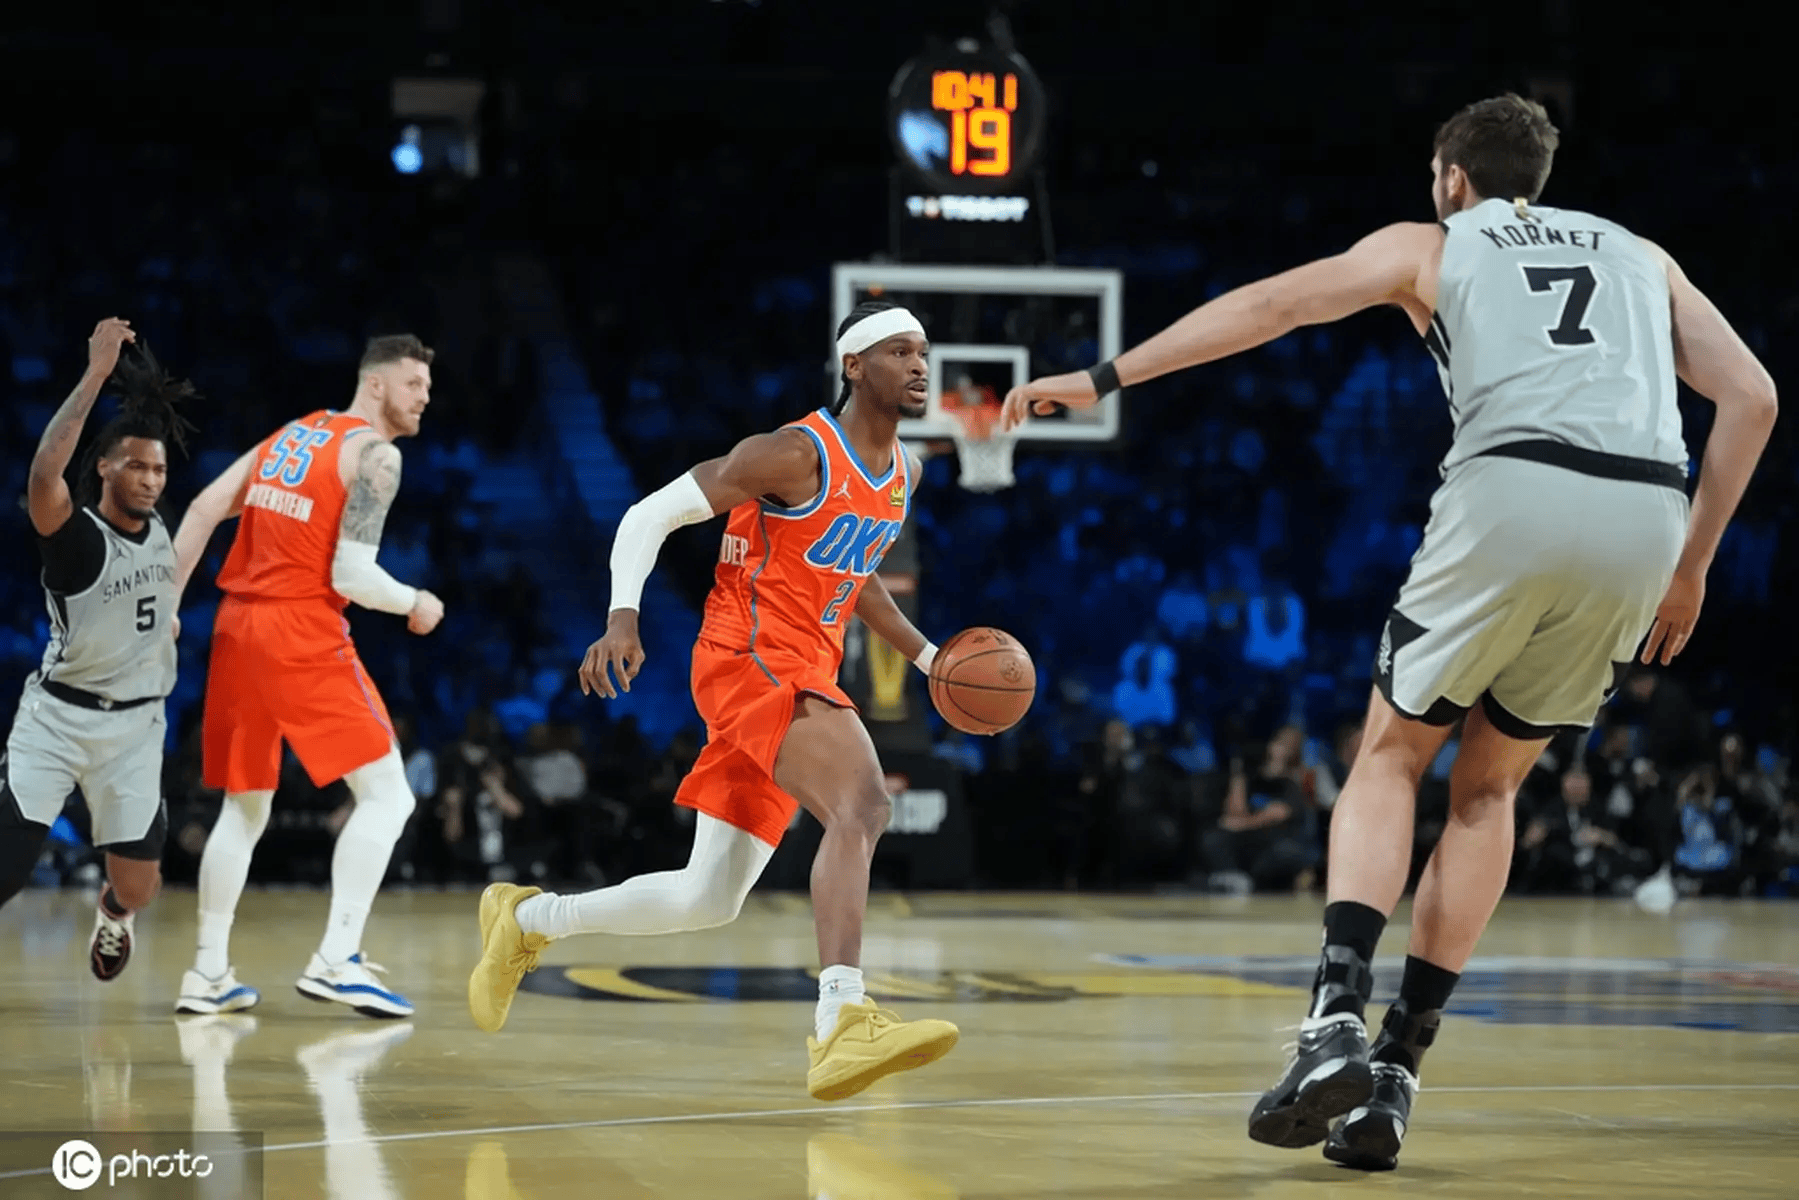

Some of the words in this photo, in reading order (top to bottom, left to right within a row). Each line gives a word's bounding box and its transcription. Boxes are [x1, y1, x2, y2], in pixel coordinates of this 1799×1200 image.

[950, 108, 1011, 175] 19
[1480, 224, 1605, 251] KORNET
[1519, 262, 1601, 348] 7
[260, 424, 334, 487] 55
[103, 575, 132, 603] SAN
[820, 580, 856, 624] 2
[136, 595, 156, 632] 5
